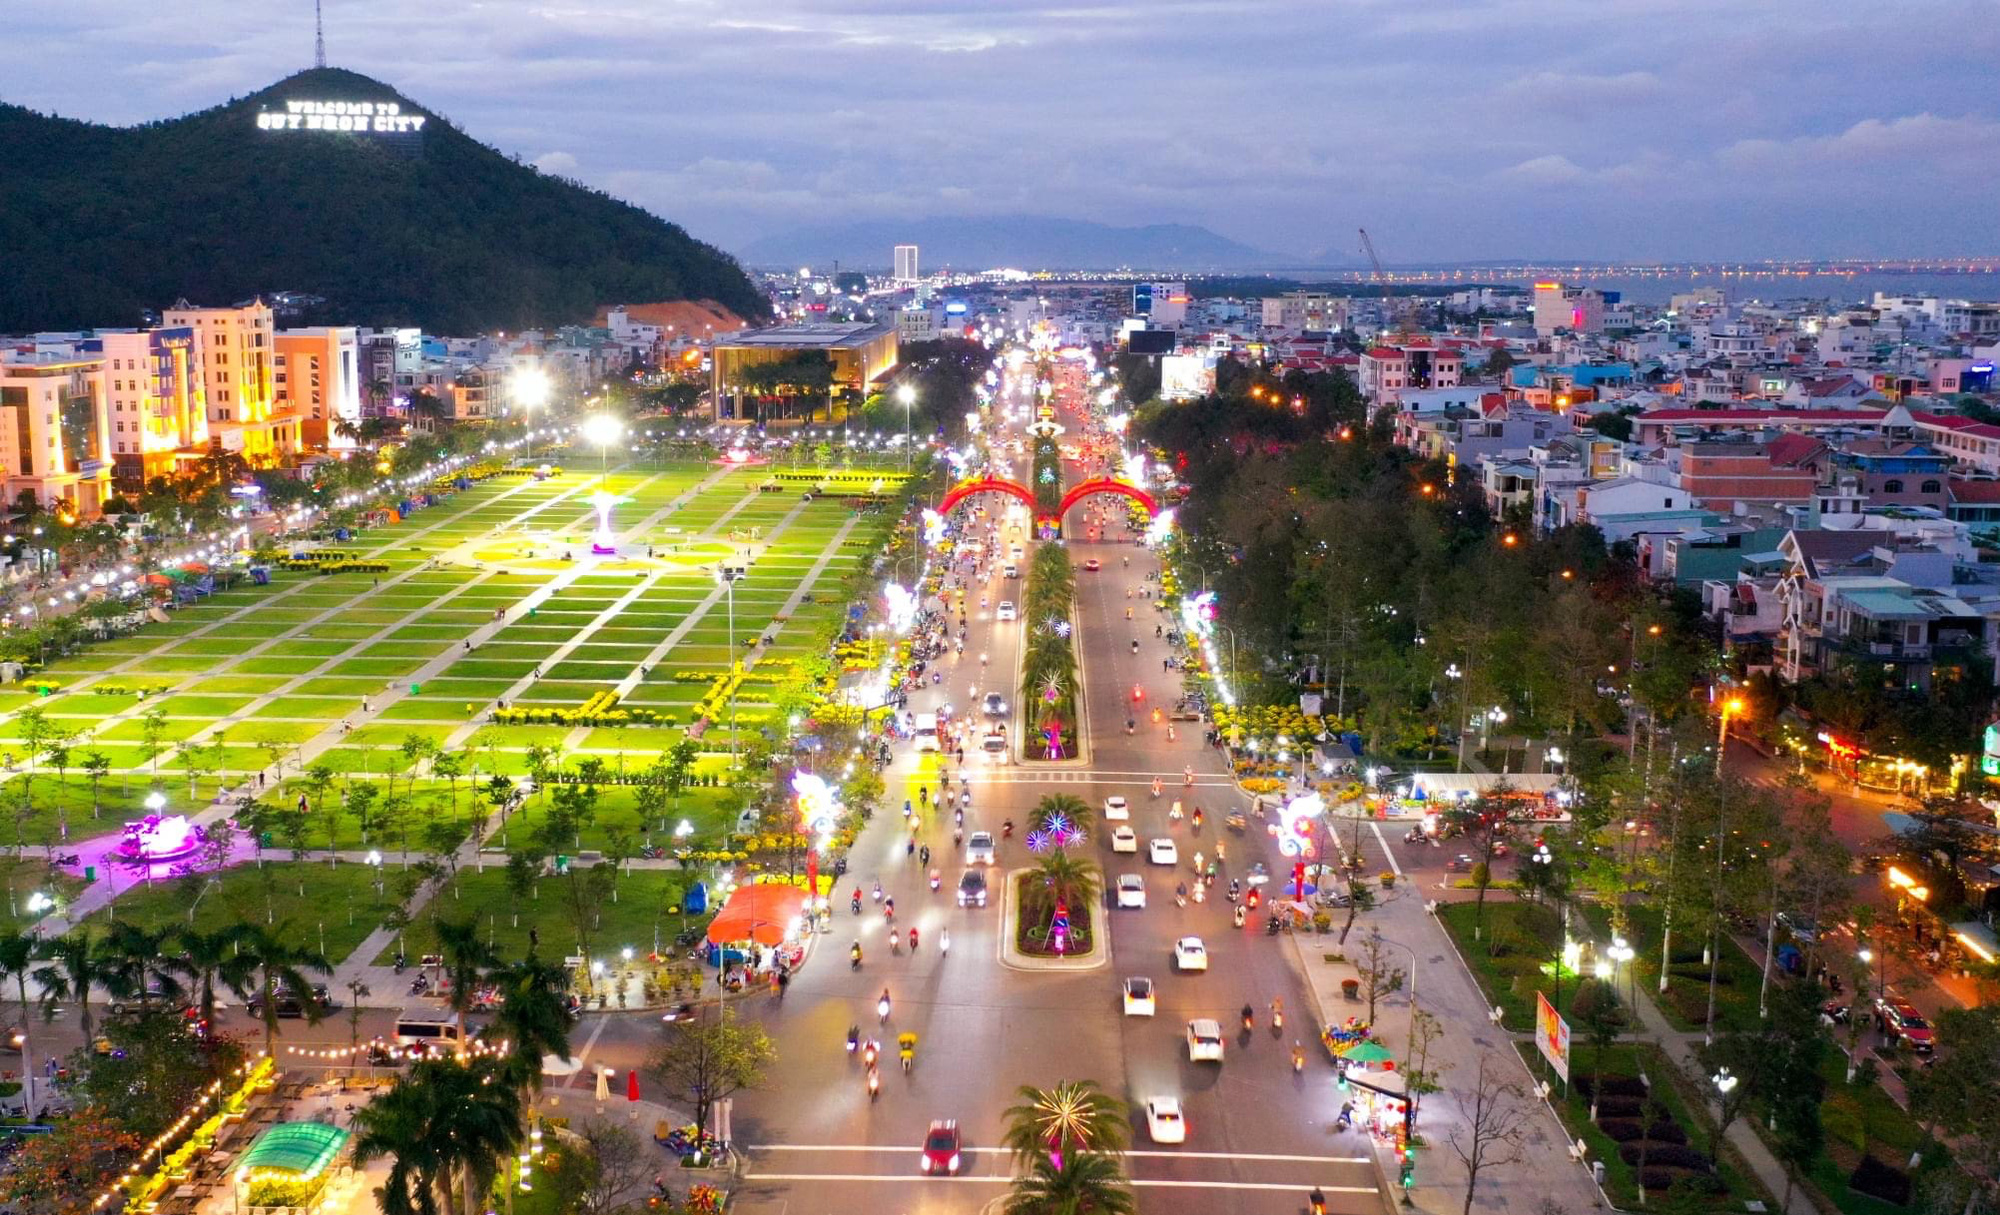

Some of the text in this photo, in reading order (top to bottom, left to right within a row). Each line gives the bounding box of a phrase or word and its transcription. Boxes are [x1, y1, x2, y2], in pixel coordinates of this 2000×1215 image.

[287, 101, 399, 116] WELCOME TO
[257, 113, 302, 130] QUY
[374, 116, 426, 132] CITY
